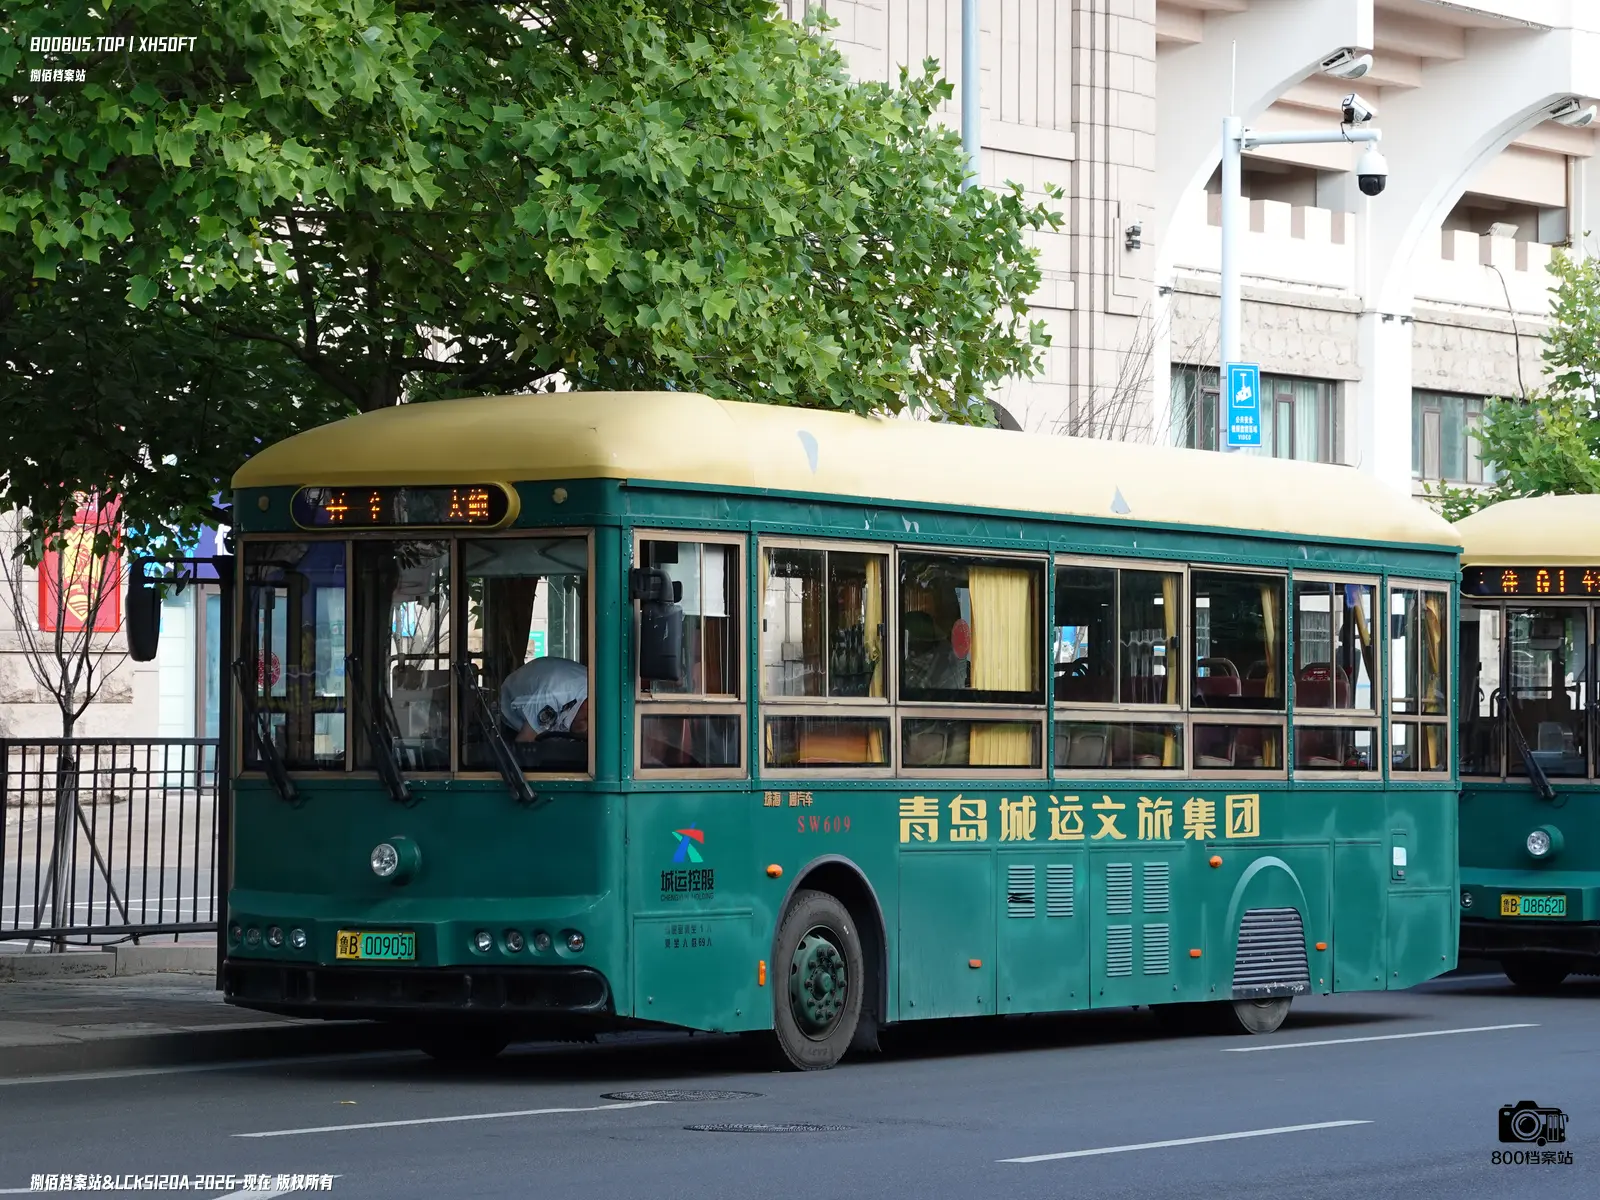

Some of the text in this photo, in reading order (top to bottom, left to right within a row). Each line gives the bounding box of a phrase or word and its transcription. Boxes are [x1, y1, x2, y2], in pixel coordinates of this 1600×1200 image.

[797, 815, 851, 833] SW609
[899, 793, 1260, 843] 青岛城运文旅集团
[660, 869, 714, 892] 城运控股
